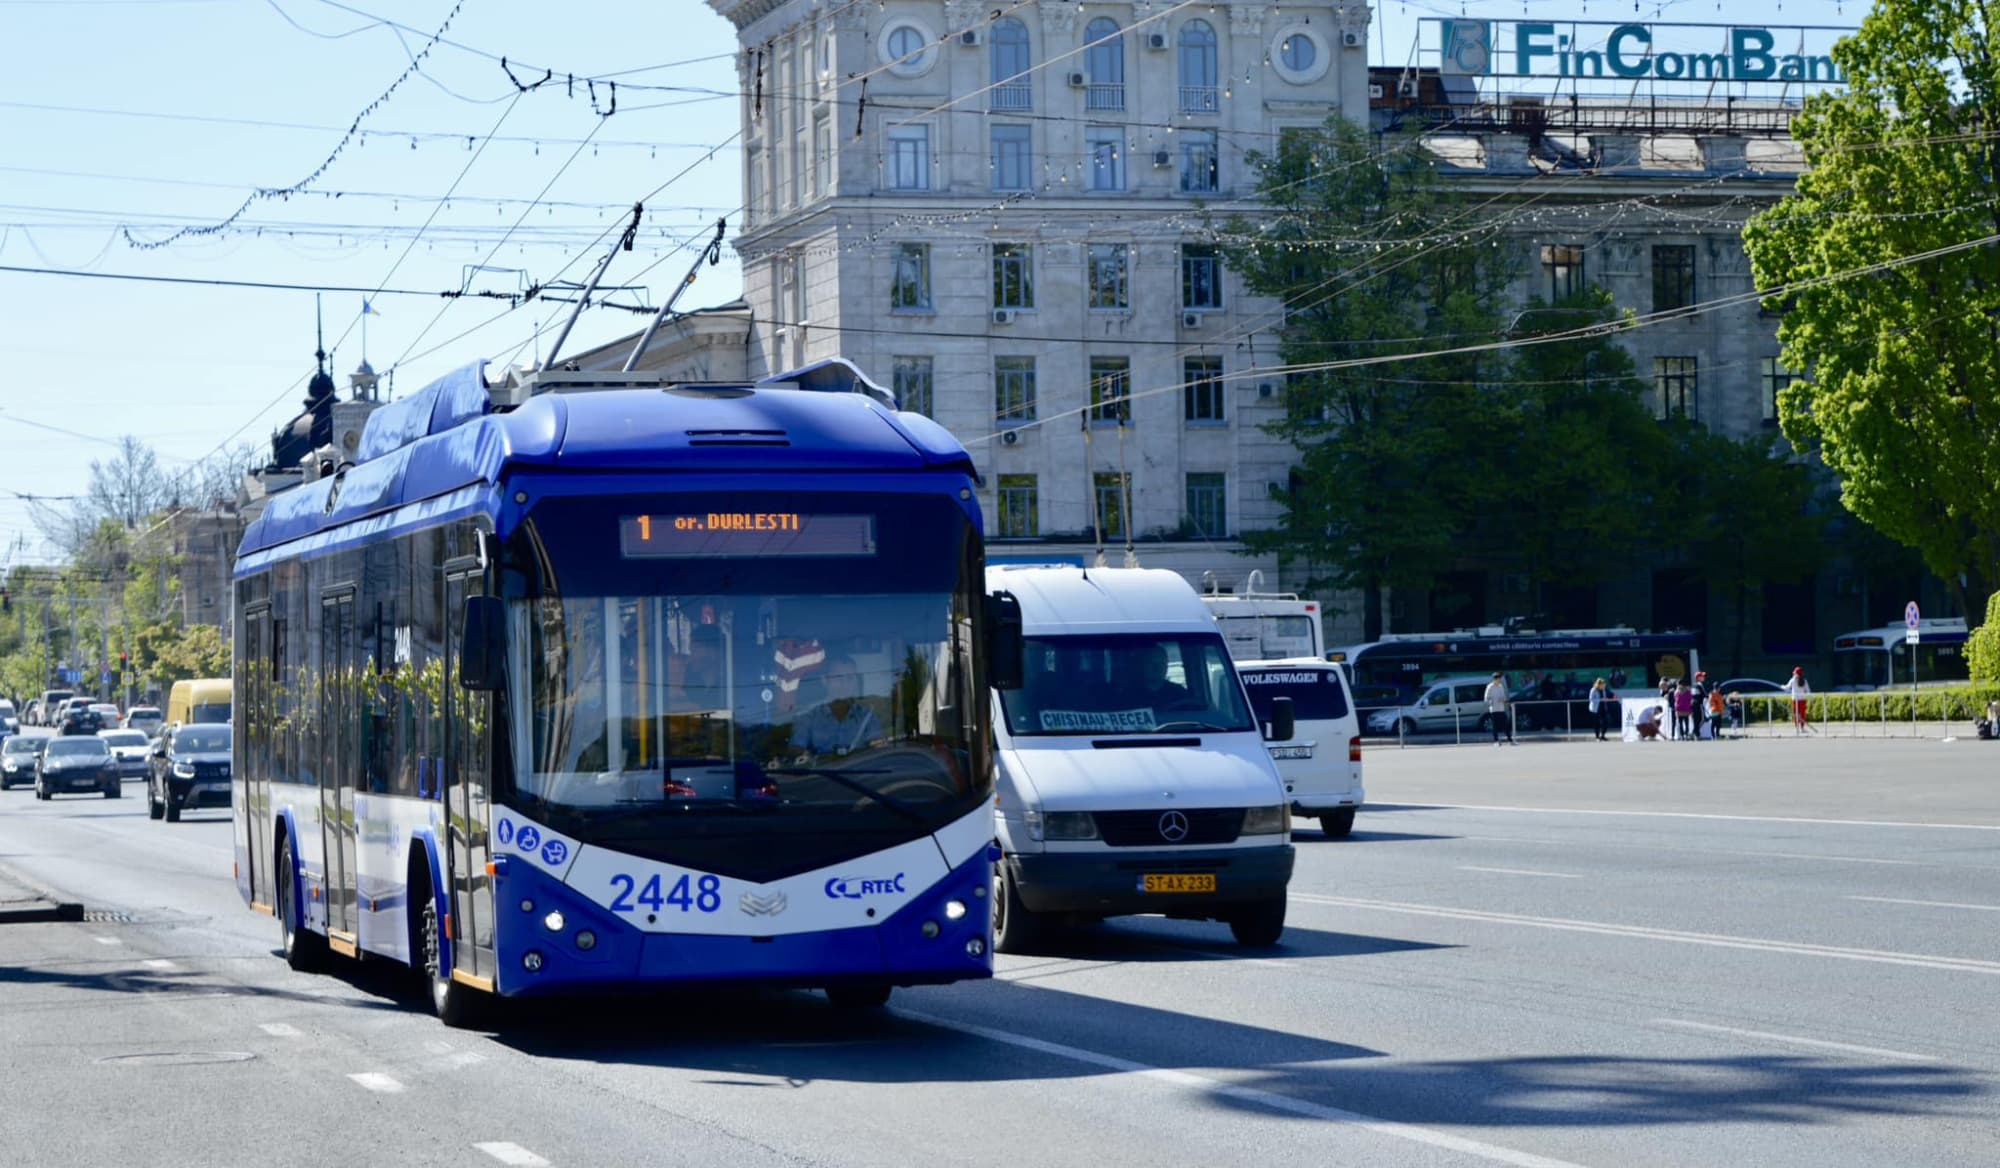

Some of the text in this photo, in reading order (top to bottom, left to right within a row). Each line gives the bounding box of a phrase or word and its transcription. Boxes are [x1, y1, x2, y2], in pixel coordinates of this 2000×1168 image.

[1516, 23, 1849, 81] FinComBan
[637, 513, 799, 540] 1 or. DURLESTI
[1243, 672, 1318, 685] VOLKSWAGEN
[609, 873, 721, 912] 2448
